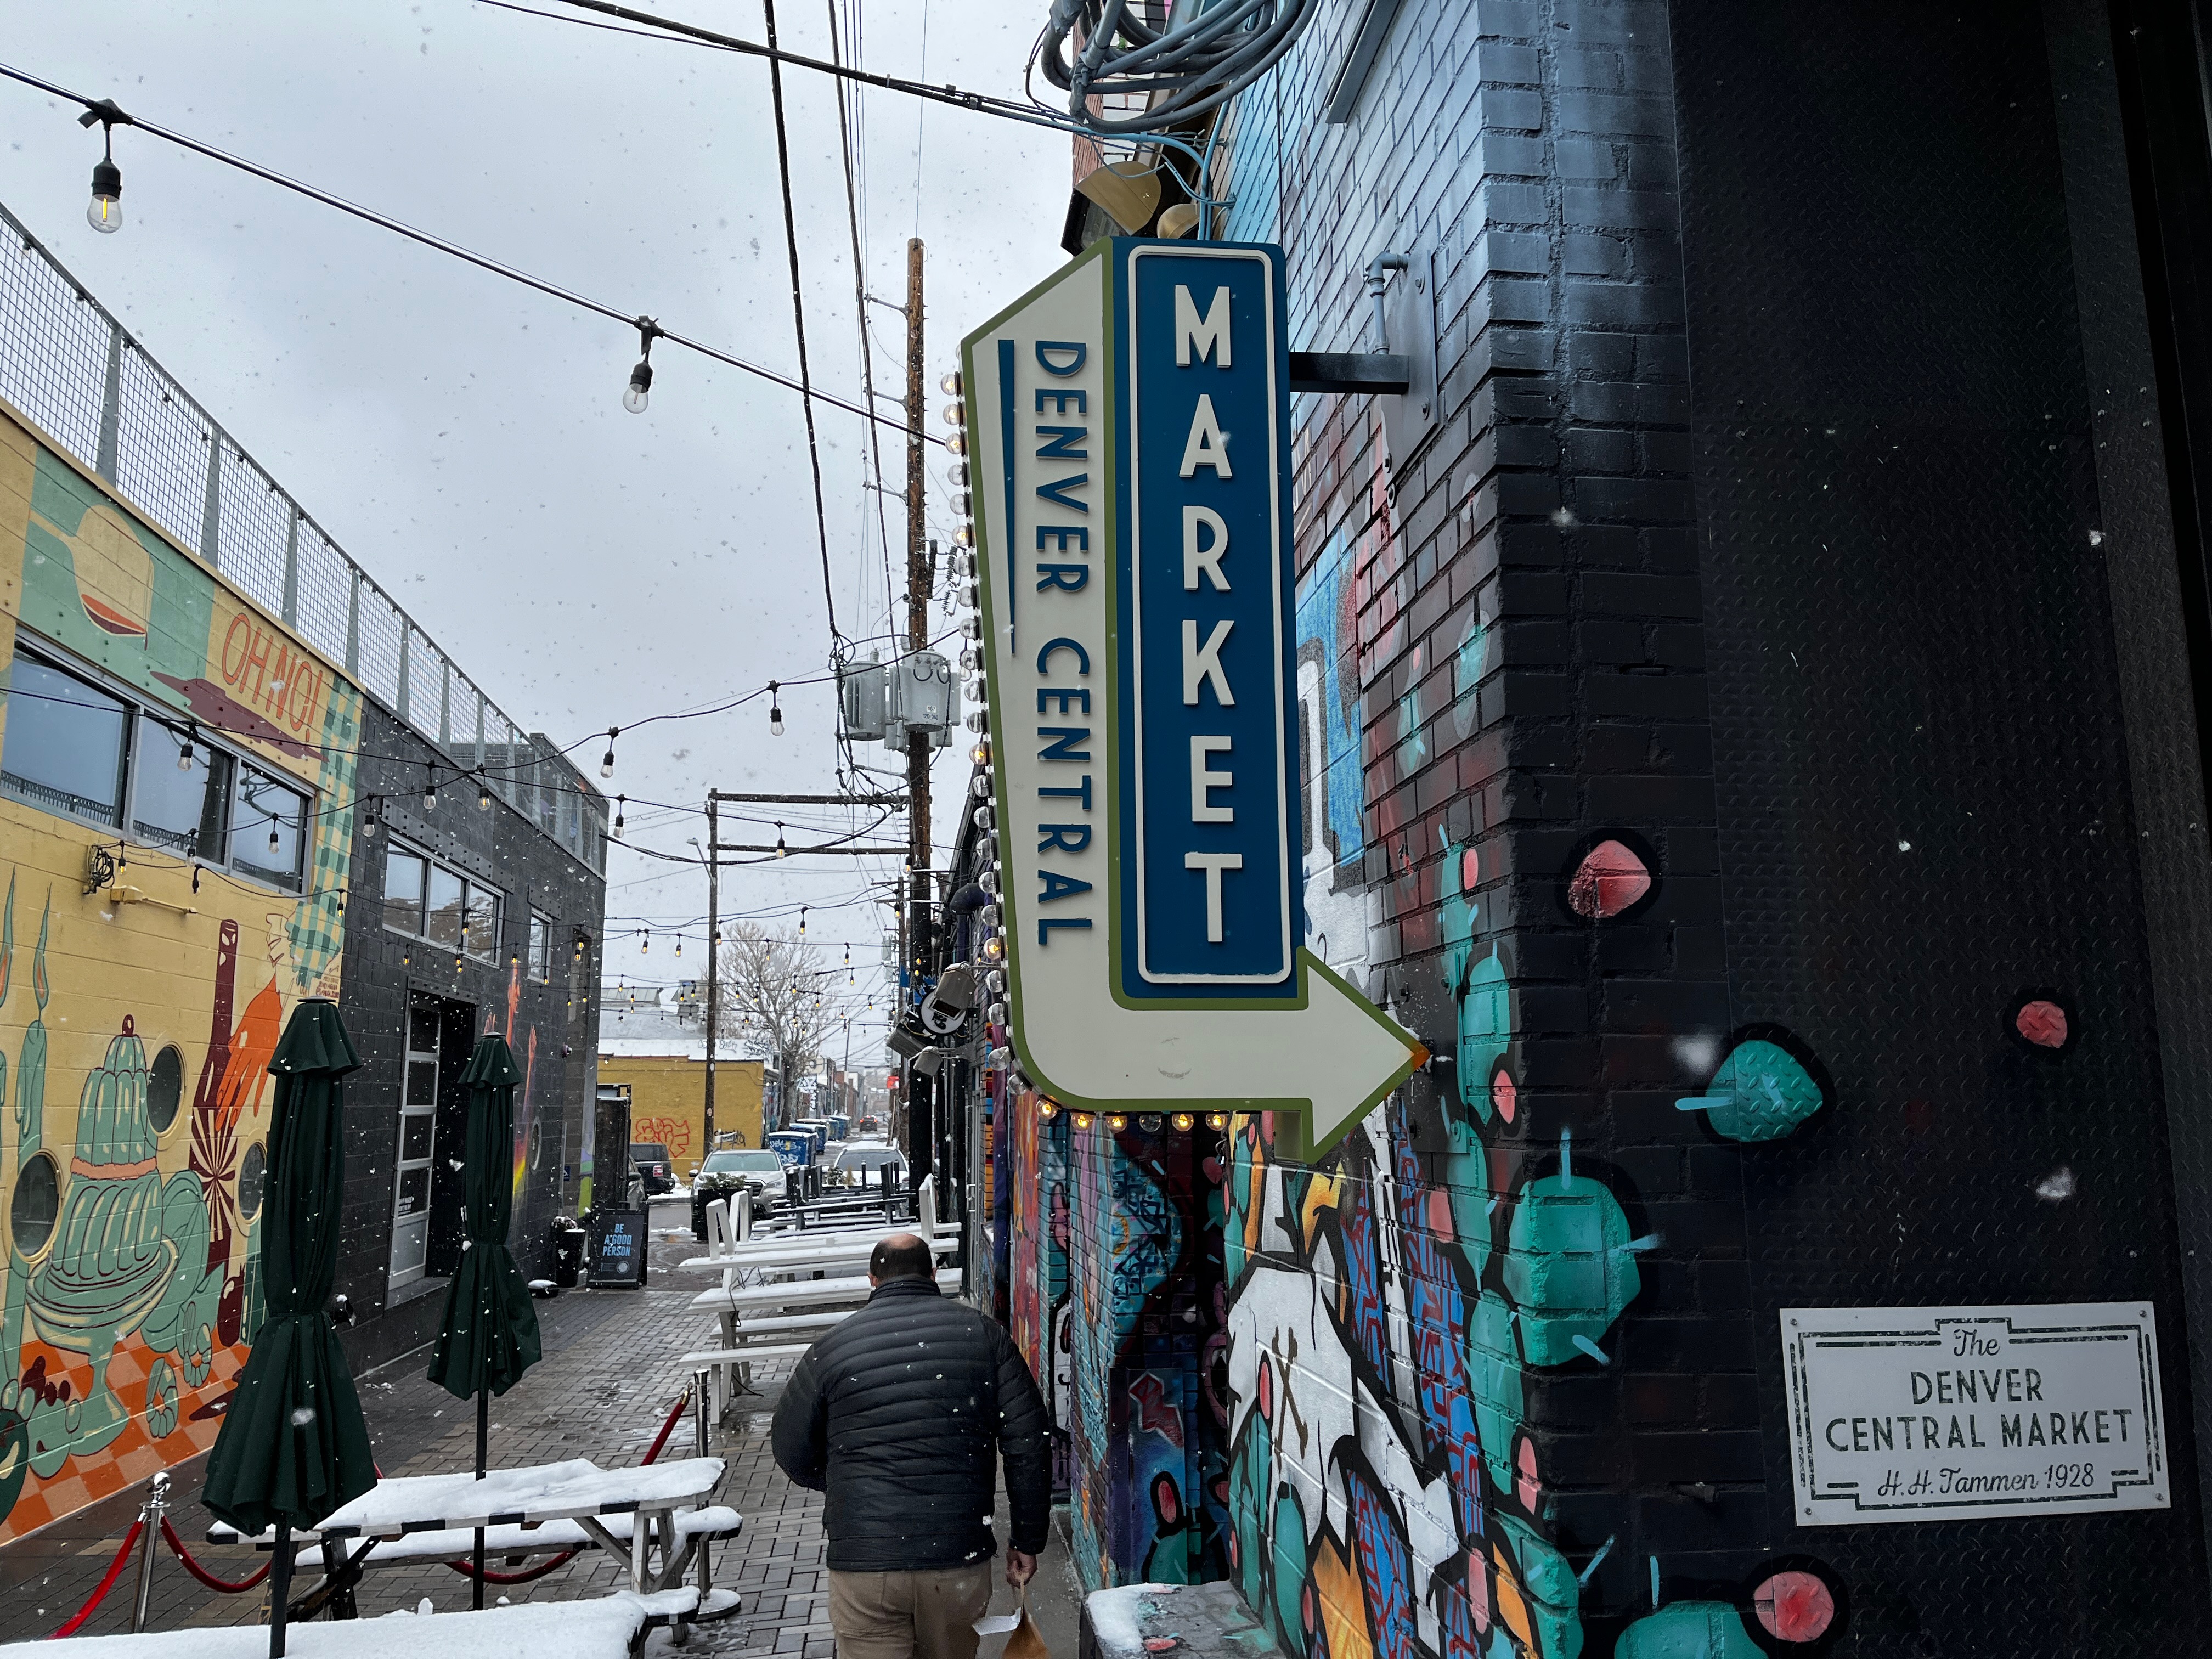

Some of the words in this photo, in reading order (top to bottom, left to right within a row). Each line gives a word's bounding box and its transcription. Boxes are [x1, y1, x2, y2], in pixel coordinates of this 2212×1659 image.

[1035, 340, 1089, 593] DENVER
[1175, 284, 1243, 943] MARKET
[222, 612, 274, 704] OH
[265, 643, 323, 743] NO!
[1036, 637, 1092, 945] CENTRAL
[604, 1234, 610, 1245] A
[612, 1234, 632, 1245] GOOD
[614, 1223, 624, 1233] BE
[602, 1246, 631, 1256] PERSON
[1953, 1328, 2001, 1357] The
[1910, 1368, 2044, 1406] DENVER
[1825, 1414, 1986, 1452] CENTRAL
[2000, 1408, 2133, 1448] MARKET
[1939, 1467, 2040, 1493] Tammen
[2044, 1462, 2095, 1488] 1928
